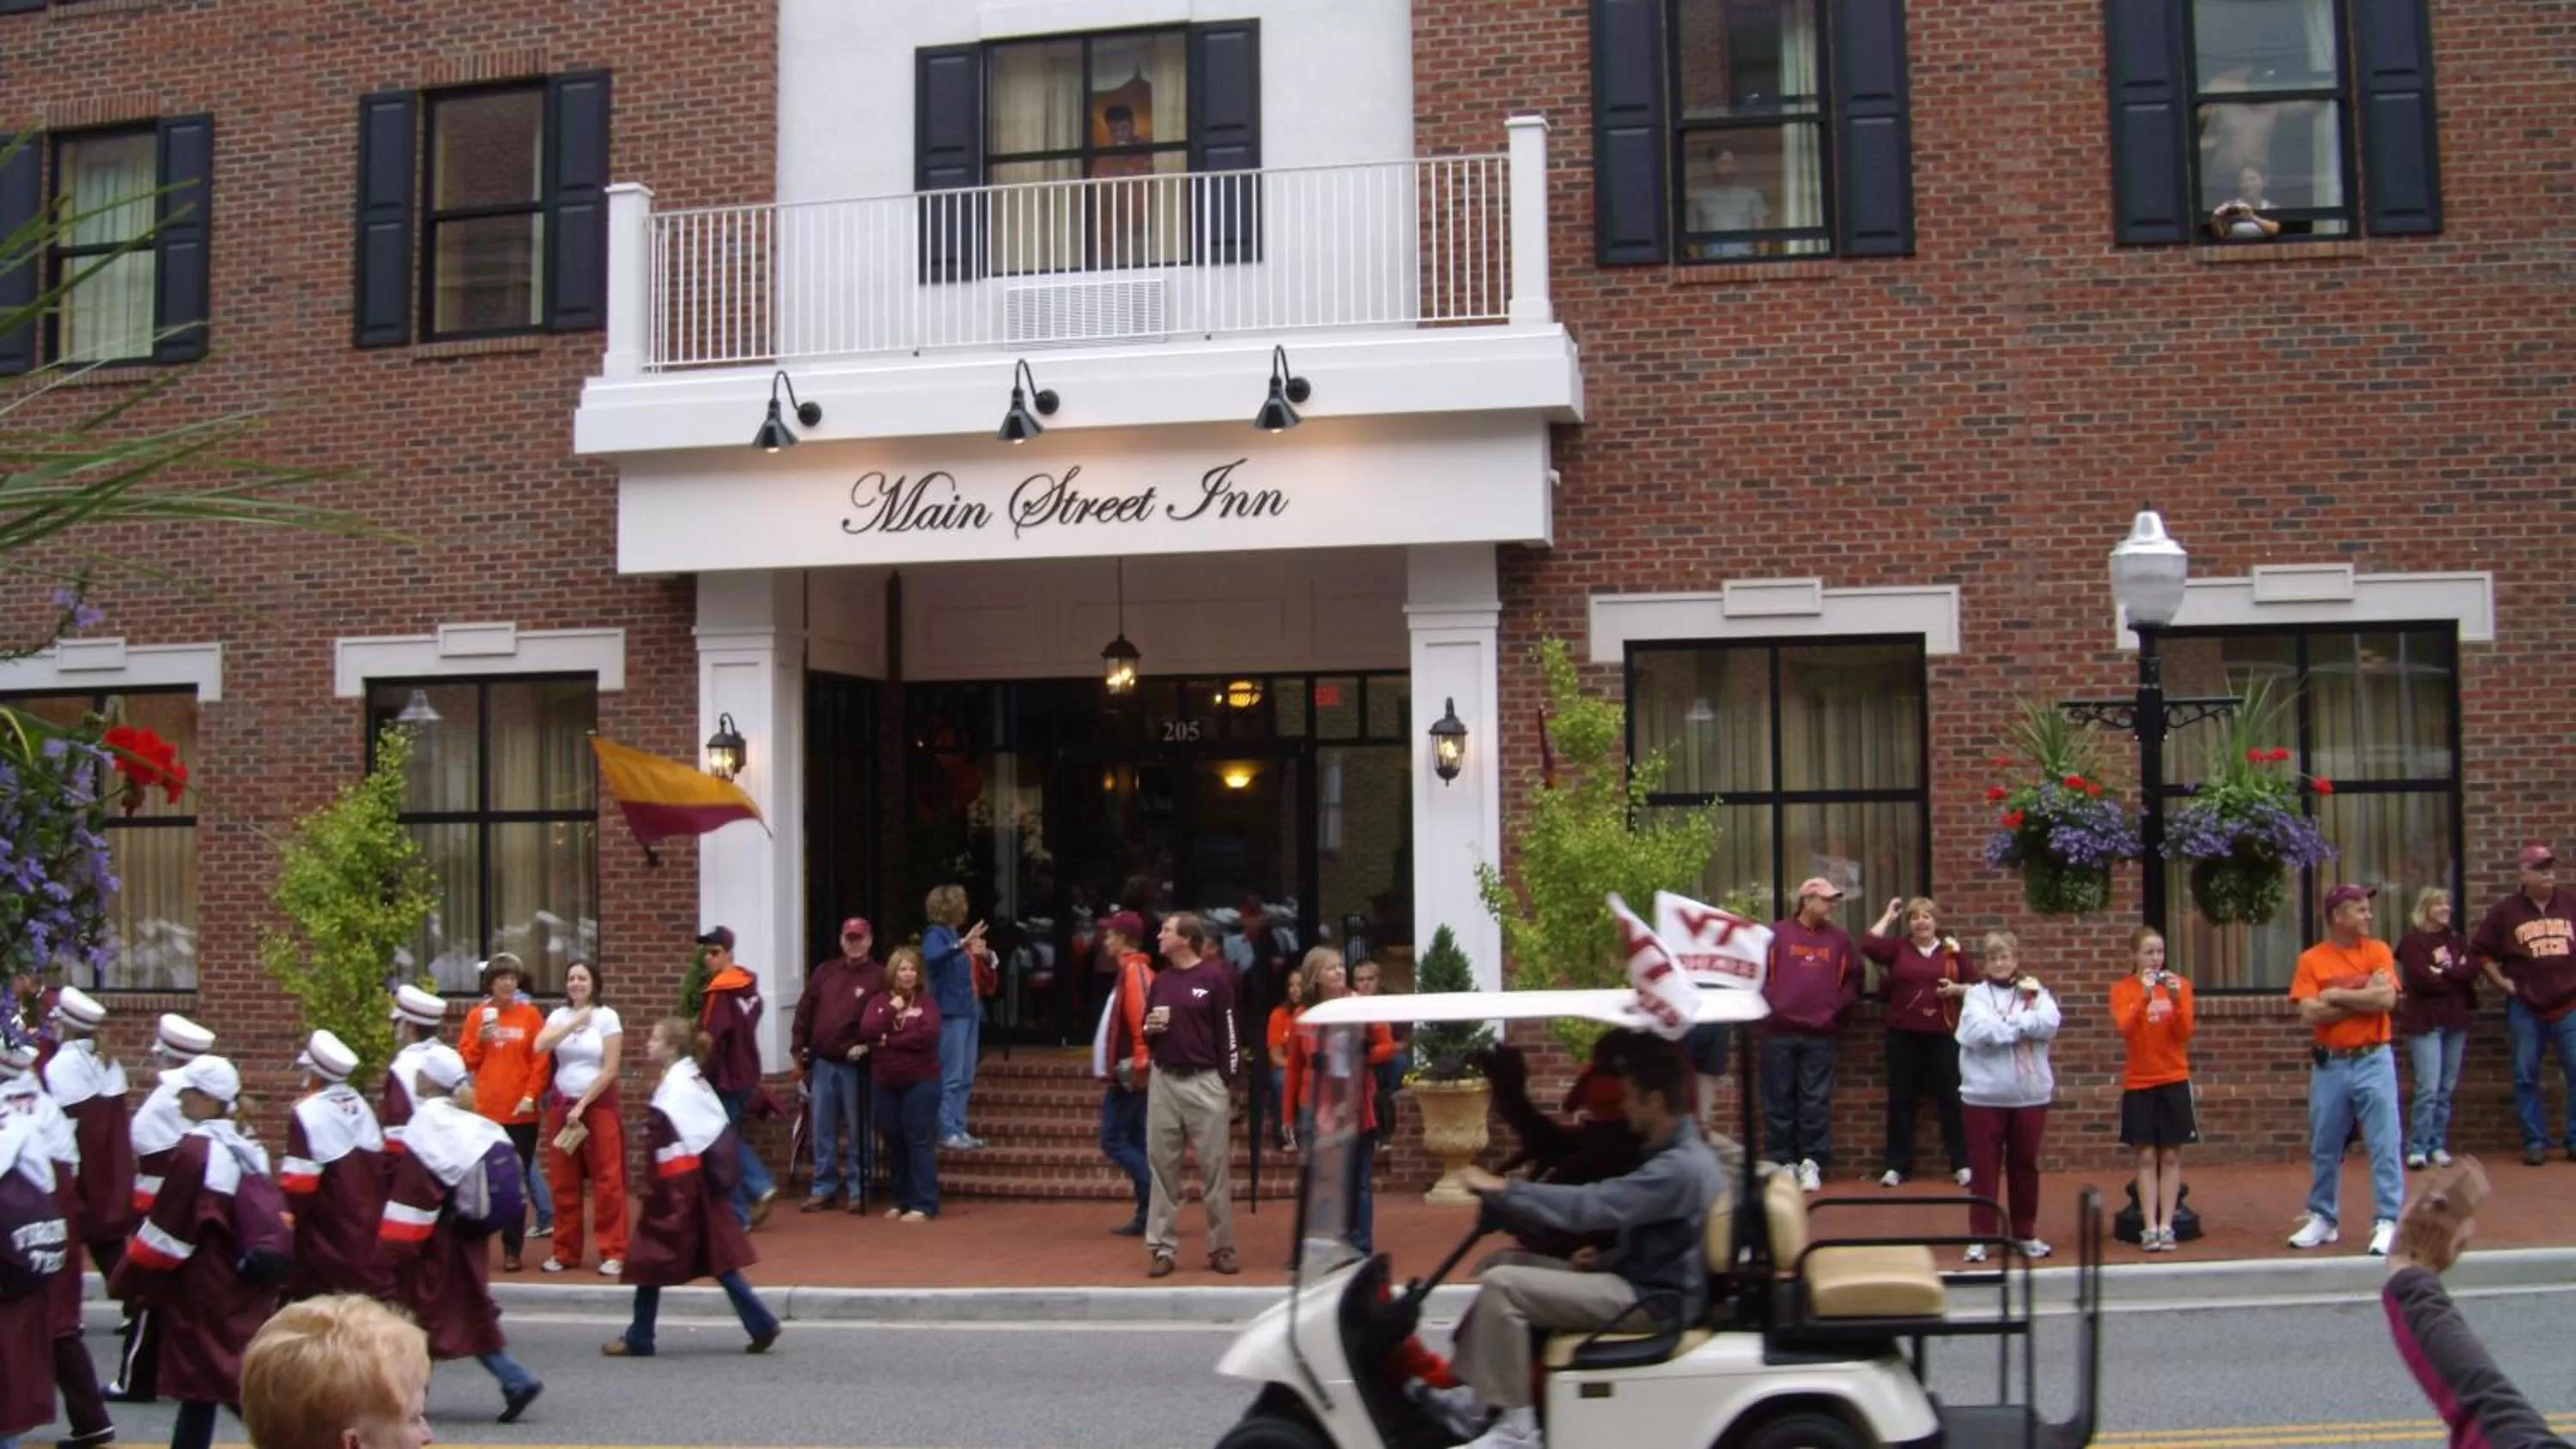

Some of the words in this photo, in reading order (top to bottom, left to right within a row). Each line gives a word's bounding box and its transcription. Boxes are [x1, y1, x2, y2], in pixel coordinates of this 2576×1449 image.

[842, 470, 993, 534] Main
[1009, 465, 1157, 539] Street
[1167, 458, 1290, 520] Inn
[1163, 720, 1200, 743] 205
